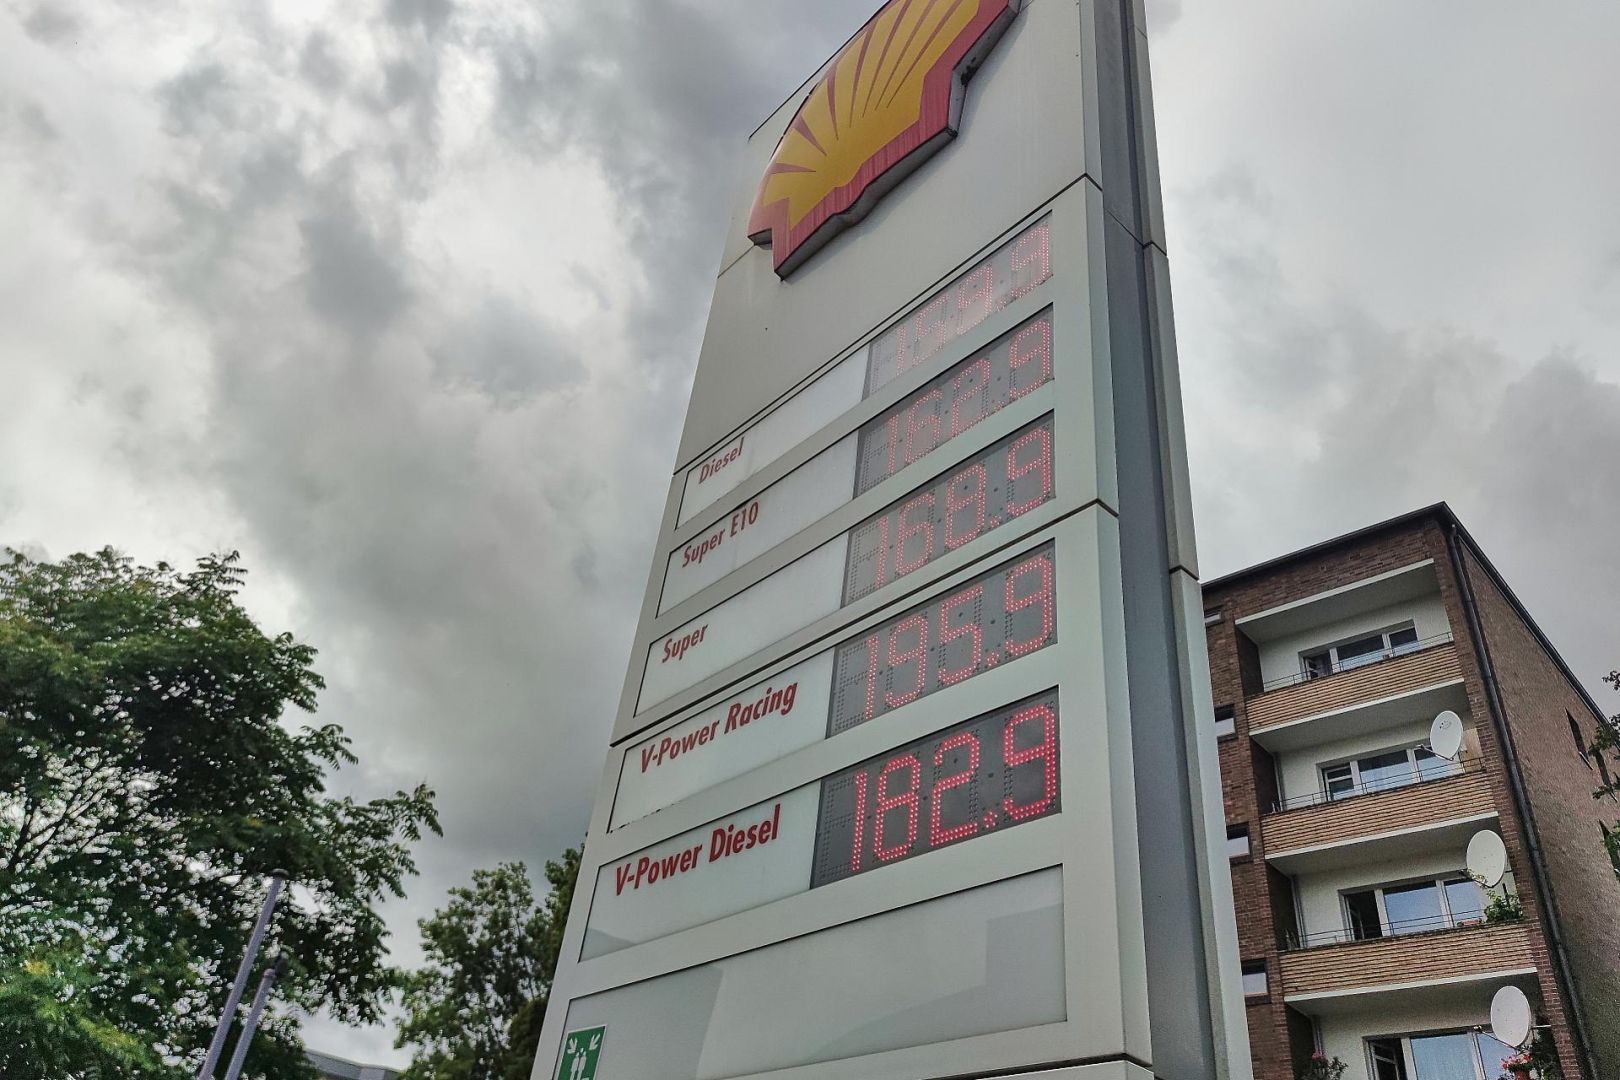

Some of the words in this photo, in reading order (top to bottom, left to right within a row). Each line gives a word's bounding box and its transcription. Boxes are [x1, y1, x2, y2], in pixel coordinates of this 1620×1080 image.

[887, 320, 1051, 475] 162.9
[698, 437, 744, 484] Diesel
[682, 526, 725, 568] Super
[730, 501, 759, 538] E10
[875, 428, 1052, 588] 168.9
[661, 624, 708, 663] Super
[864, 554, 1053, 720] 195.9
[640, 719, 719, 773] V-Power
[724, 682, 798, 734] Racing
[851, 703, 1056, 872] 182.9
[616, 844, 702, 896] V-Power
[709, 803, 781, 863] Diesel
